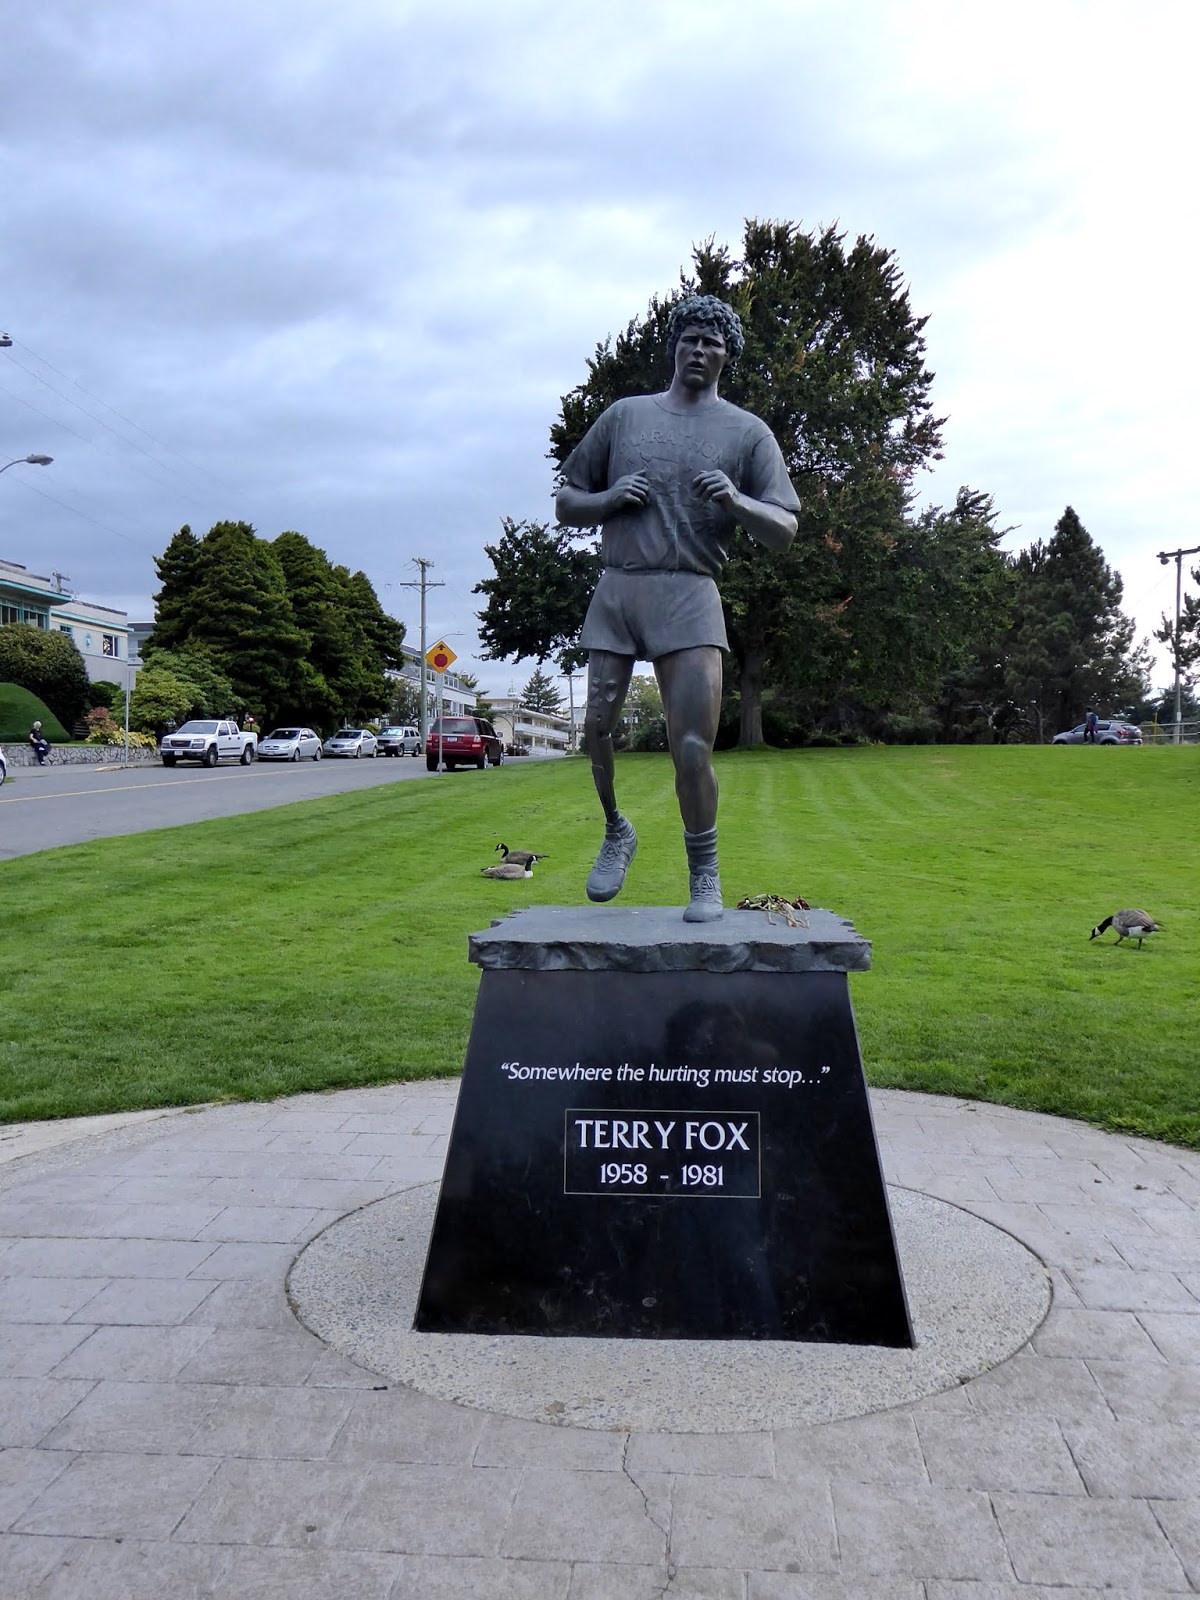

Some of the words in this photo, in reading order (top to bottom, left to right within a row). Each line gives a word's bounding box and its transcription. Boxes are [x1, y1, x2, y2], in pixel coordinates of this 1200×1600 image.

[500, 1062, 613, 1081] “Somewhere
[616, 1063, 645, 1082] the
[648, 1063, 712, 1088] hurting
[714, 1066, 759, 1083] must
[574, 1119, 676, 1150] TERRY
[685, 1121, 751, 1151] FOX
[600, 1163, 648, 1185] 1958
[681, 1164, 724, 1186] 1981
